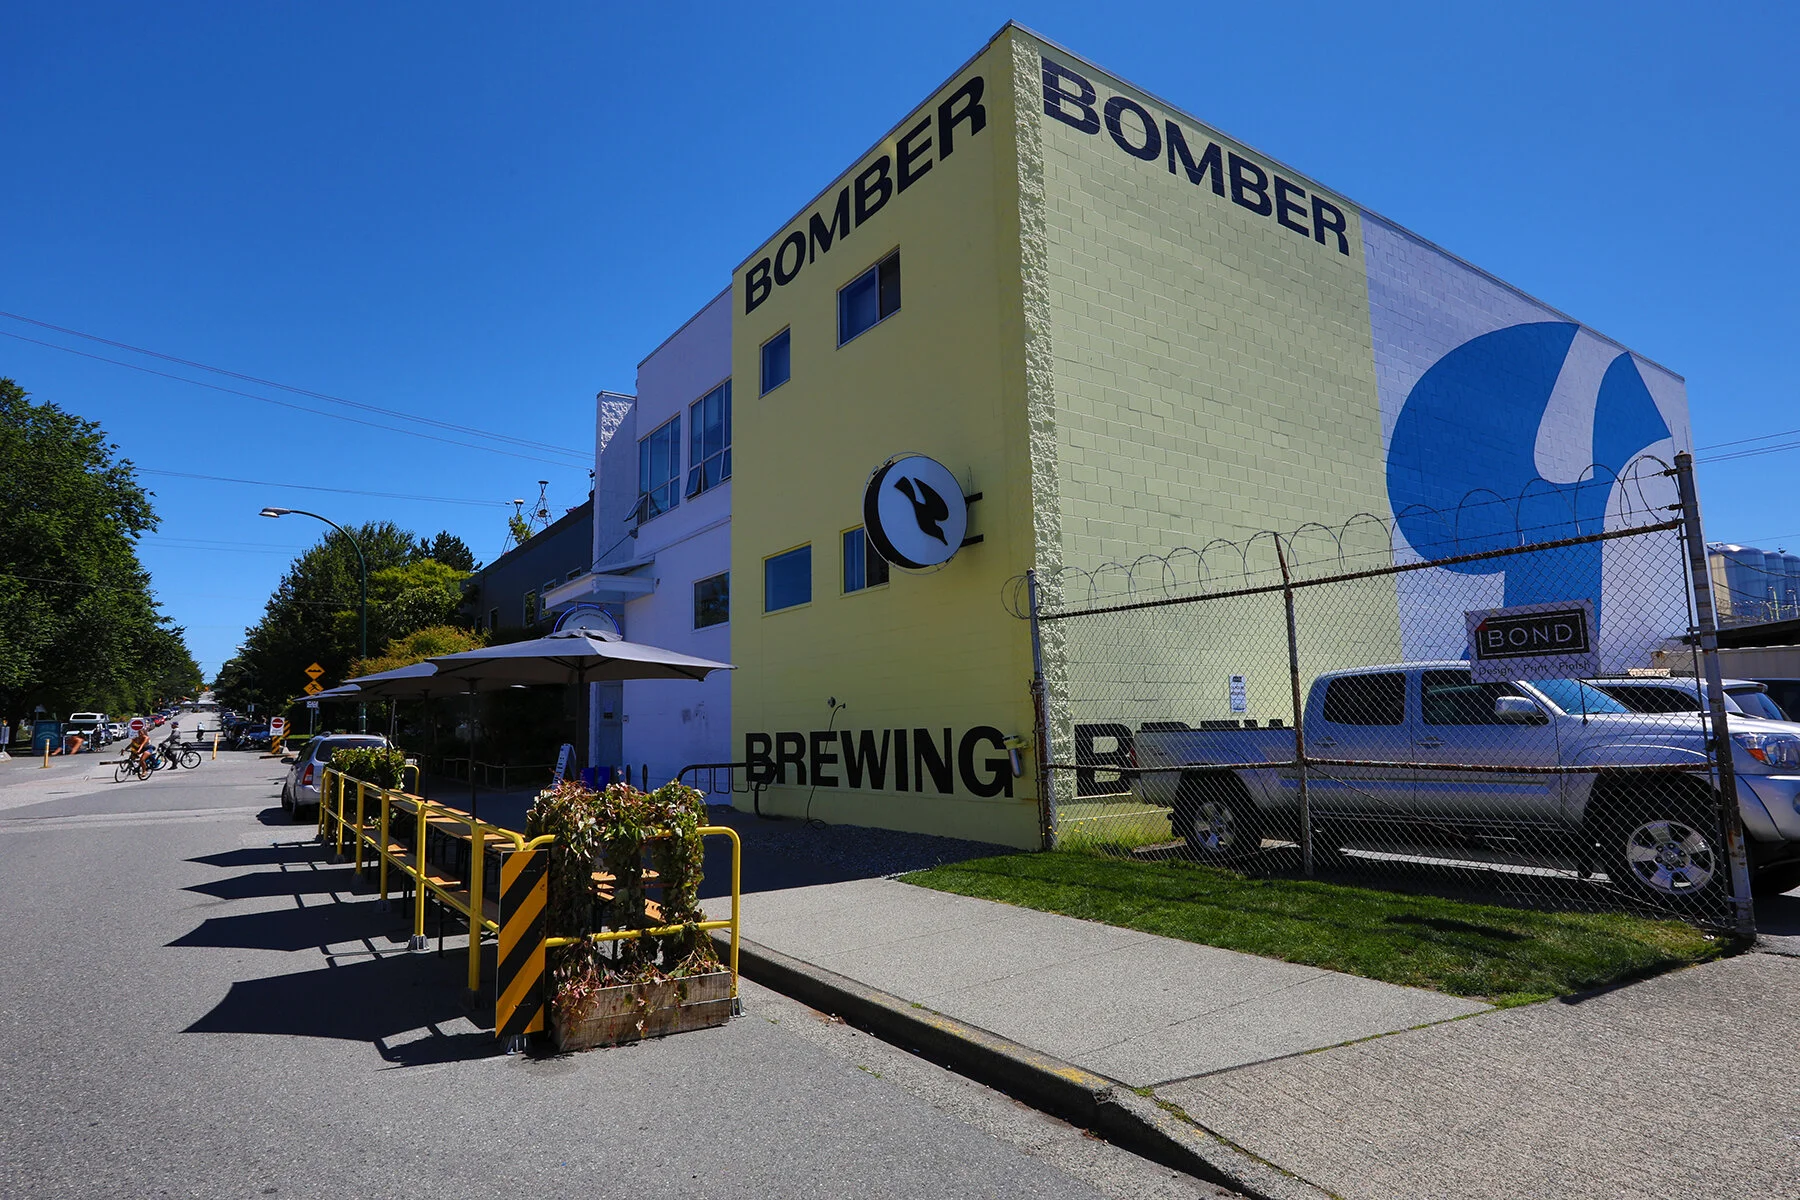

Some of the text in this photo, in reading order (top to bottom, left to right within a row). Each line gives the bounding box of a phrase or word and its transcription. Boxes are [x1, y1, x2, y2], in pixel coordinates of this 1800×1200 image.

[1041, 55, 1350, 257] BOMBER
[745, 75, 987, 316] BOMBER
[1478, 660, 1591, 677] Design Print Finish
[1487, 623, 1573, 648] BOND
[745, 726, 1014, 798] BREWING
